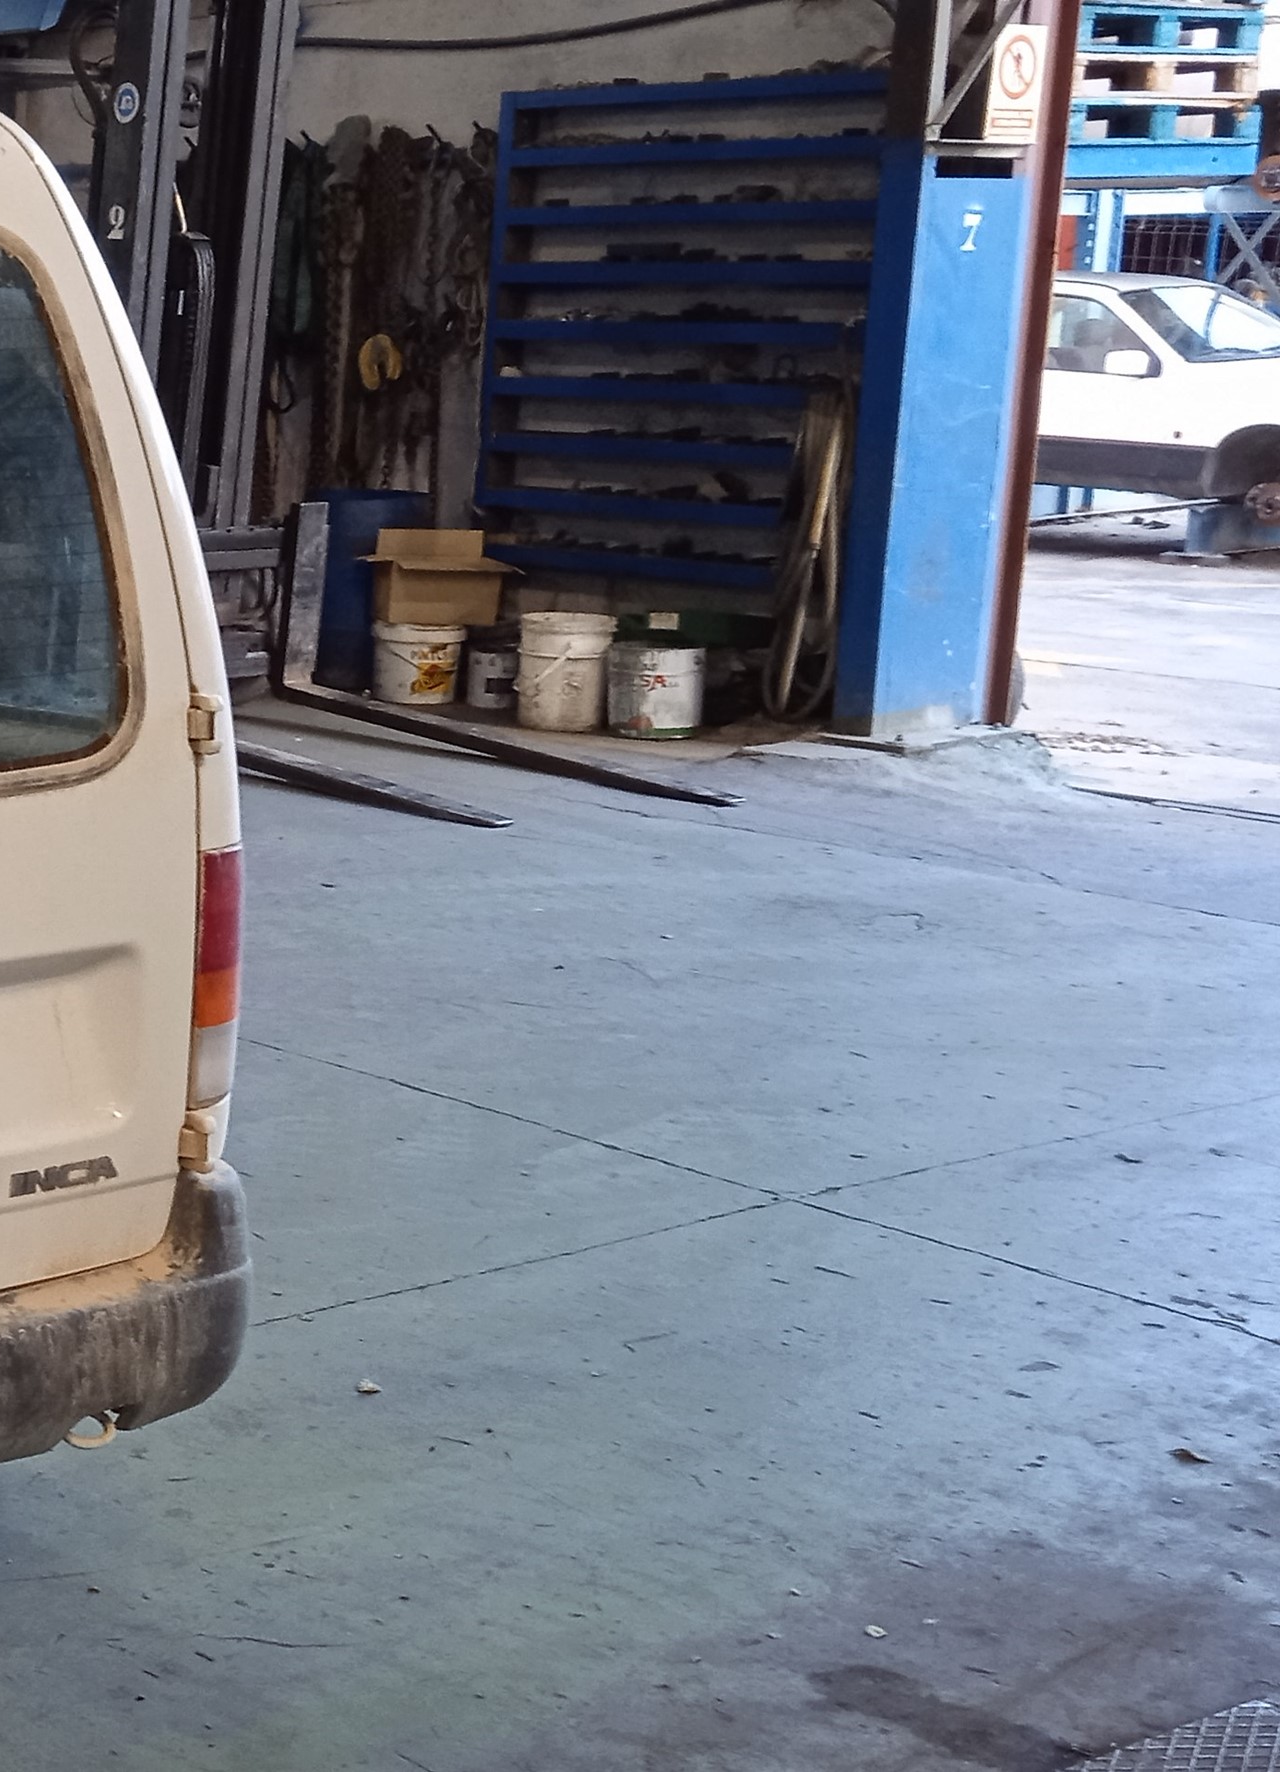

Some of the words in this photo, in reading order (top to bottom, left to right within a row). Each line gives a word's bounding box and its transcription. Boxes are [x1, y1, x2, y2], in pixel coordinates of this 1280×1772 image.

[107, 204, 125, 240] 2
[959, 211, 983, 252] 7
[8, 1155, 119, 1199] INCA
